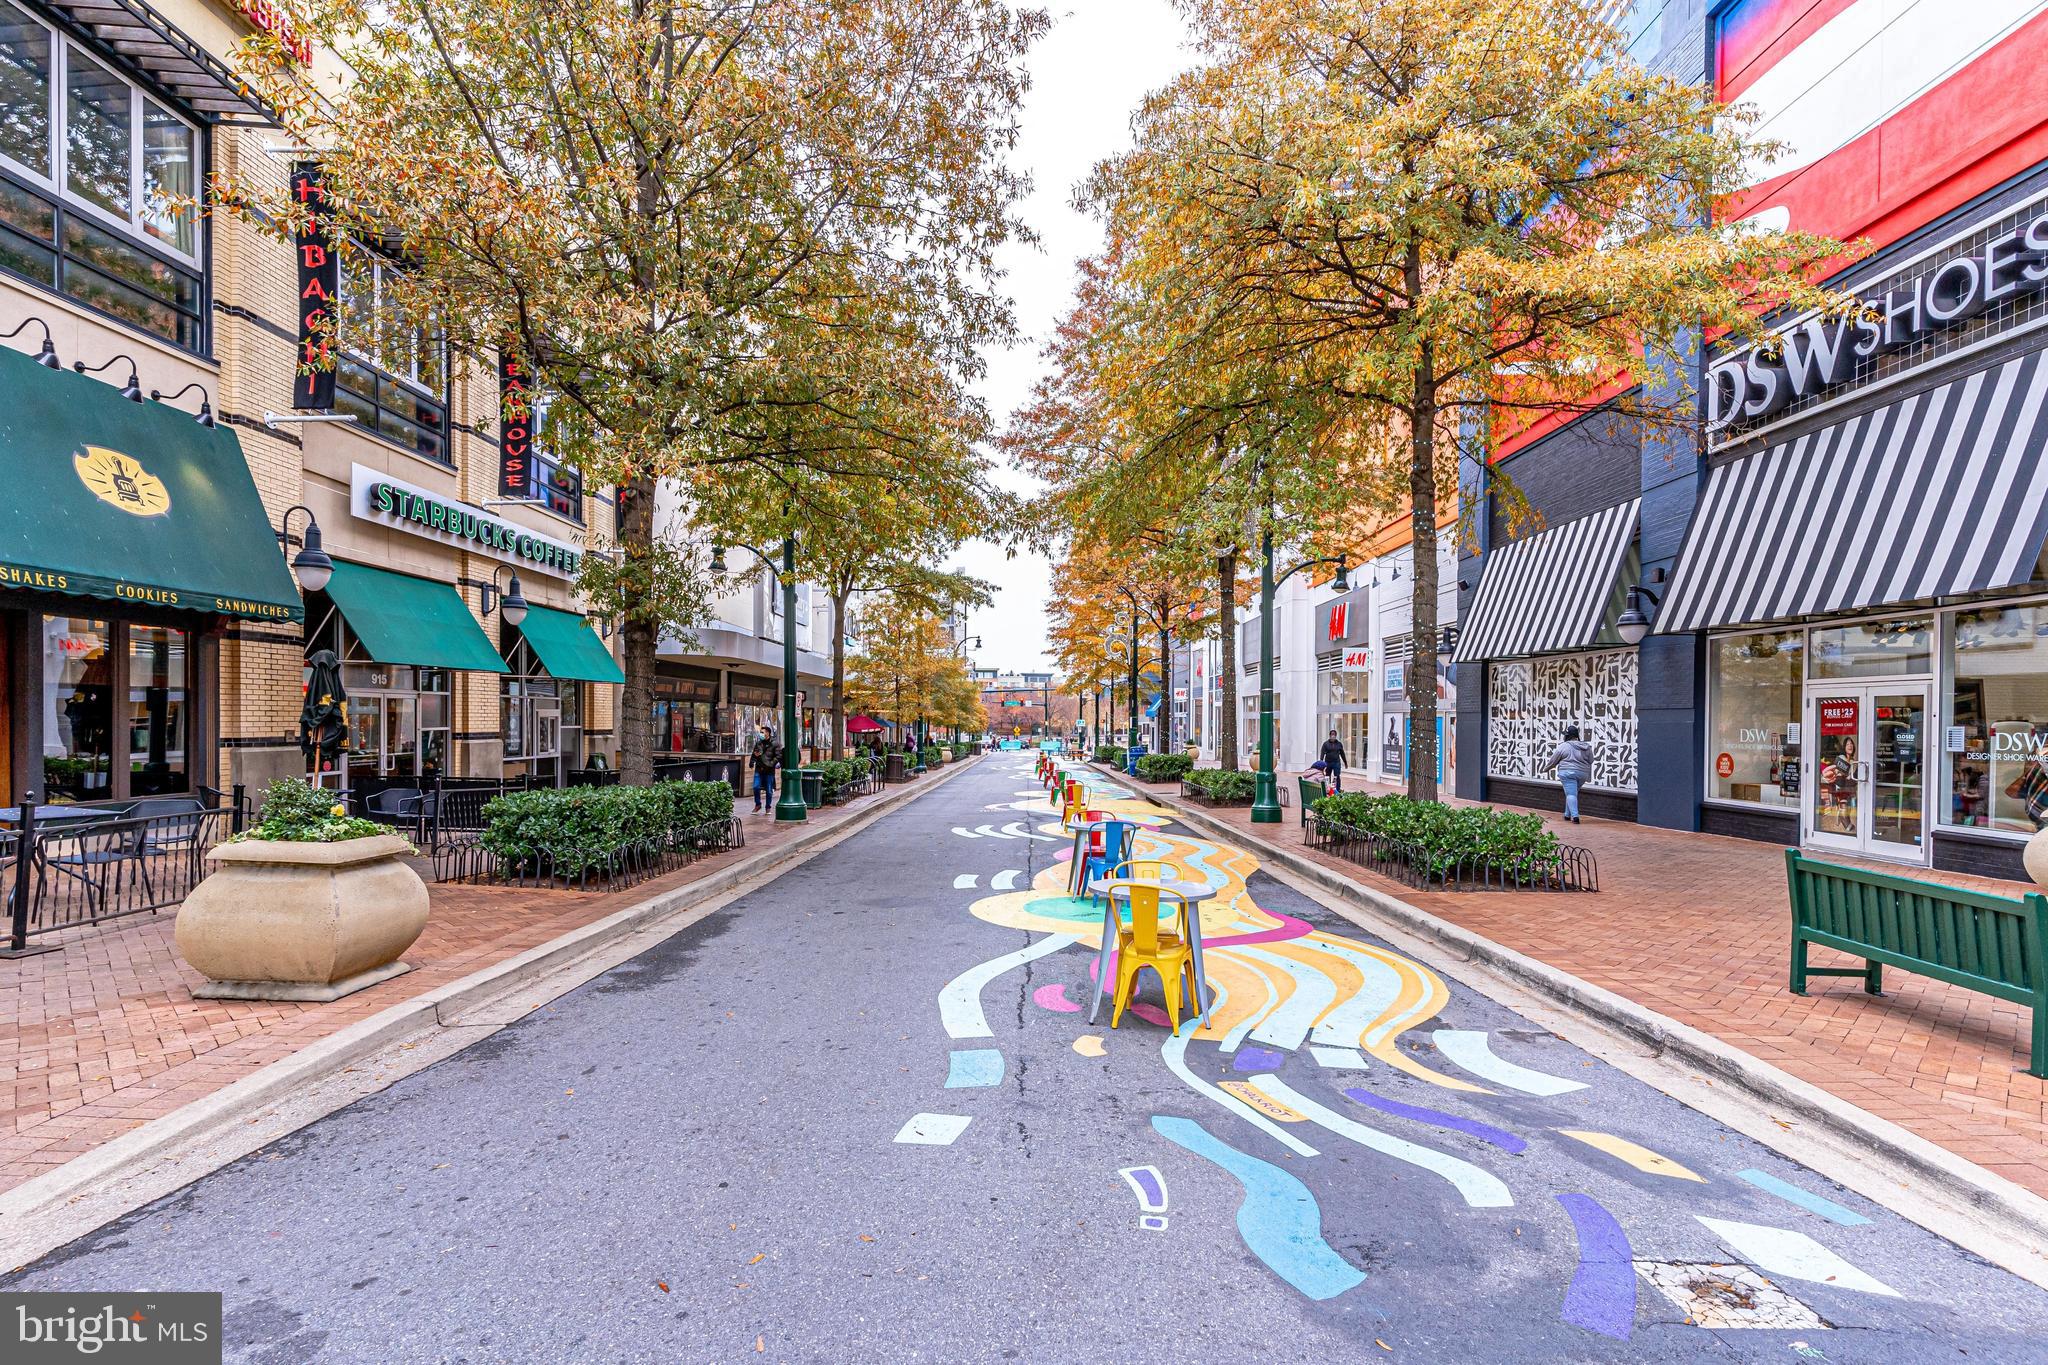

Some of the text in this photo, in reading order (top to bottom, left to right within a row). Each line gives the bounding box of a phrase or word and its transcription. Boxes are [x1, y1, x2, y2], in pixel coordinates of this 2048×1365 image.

[1704, 214, 2048, 434] DSW SHOES
[377, 482, 517, 552] STARBUCKS
[0, 567, 67, 588] SHAKES
[116, 584, 178, 604] COOKIES
[215, 598, 290, 618] SANDWICHES
[1345, 652, 1367, 667] H&M
[371, 673, 387, 685] 915
[1824, 708, 1840, 716] FREE
[1740, 728, 1769, 743] DSW
[1995, 732, 2048, 752] DSW
[1966, 752, 2002, 761] DESIGNER
[2003, 753, 2024, 762] SHOE
